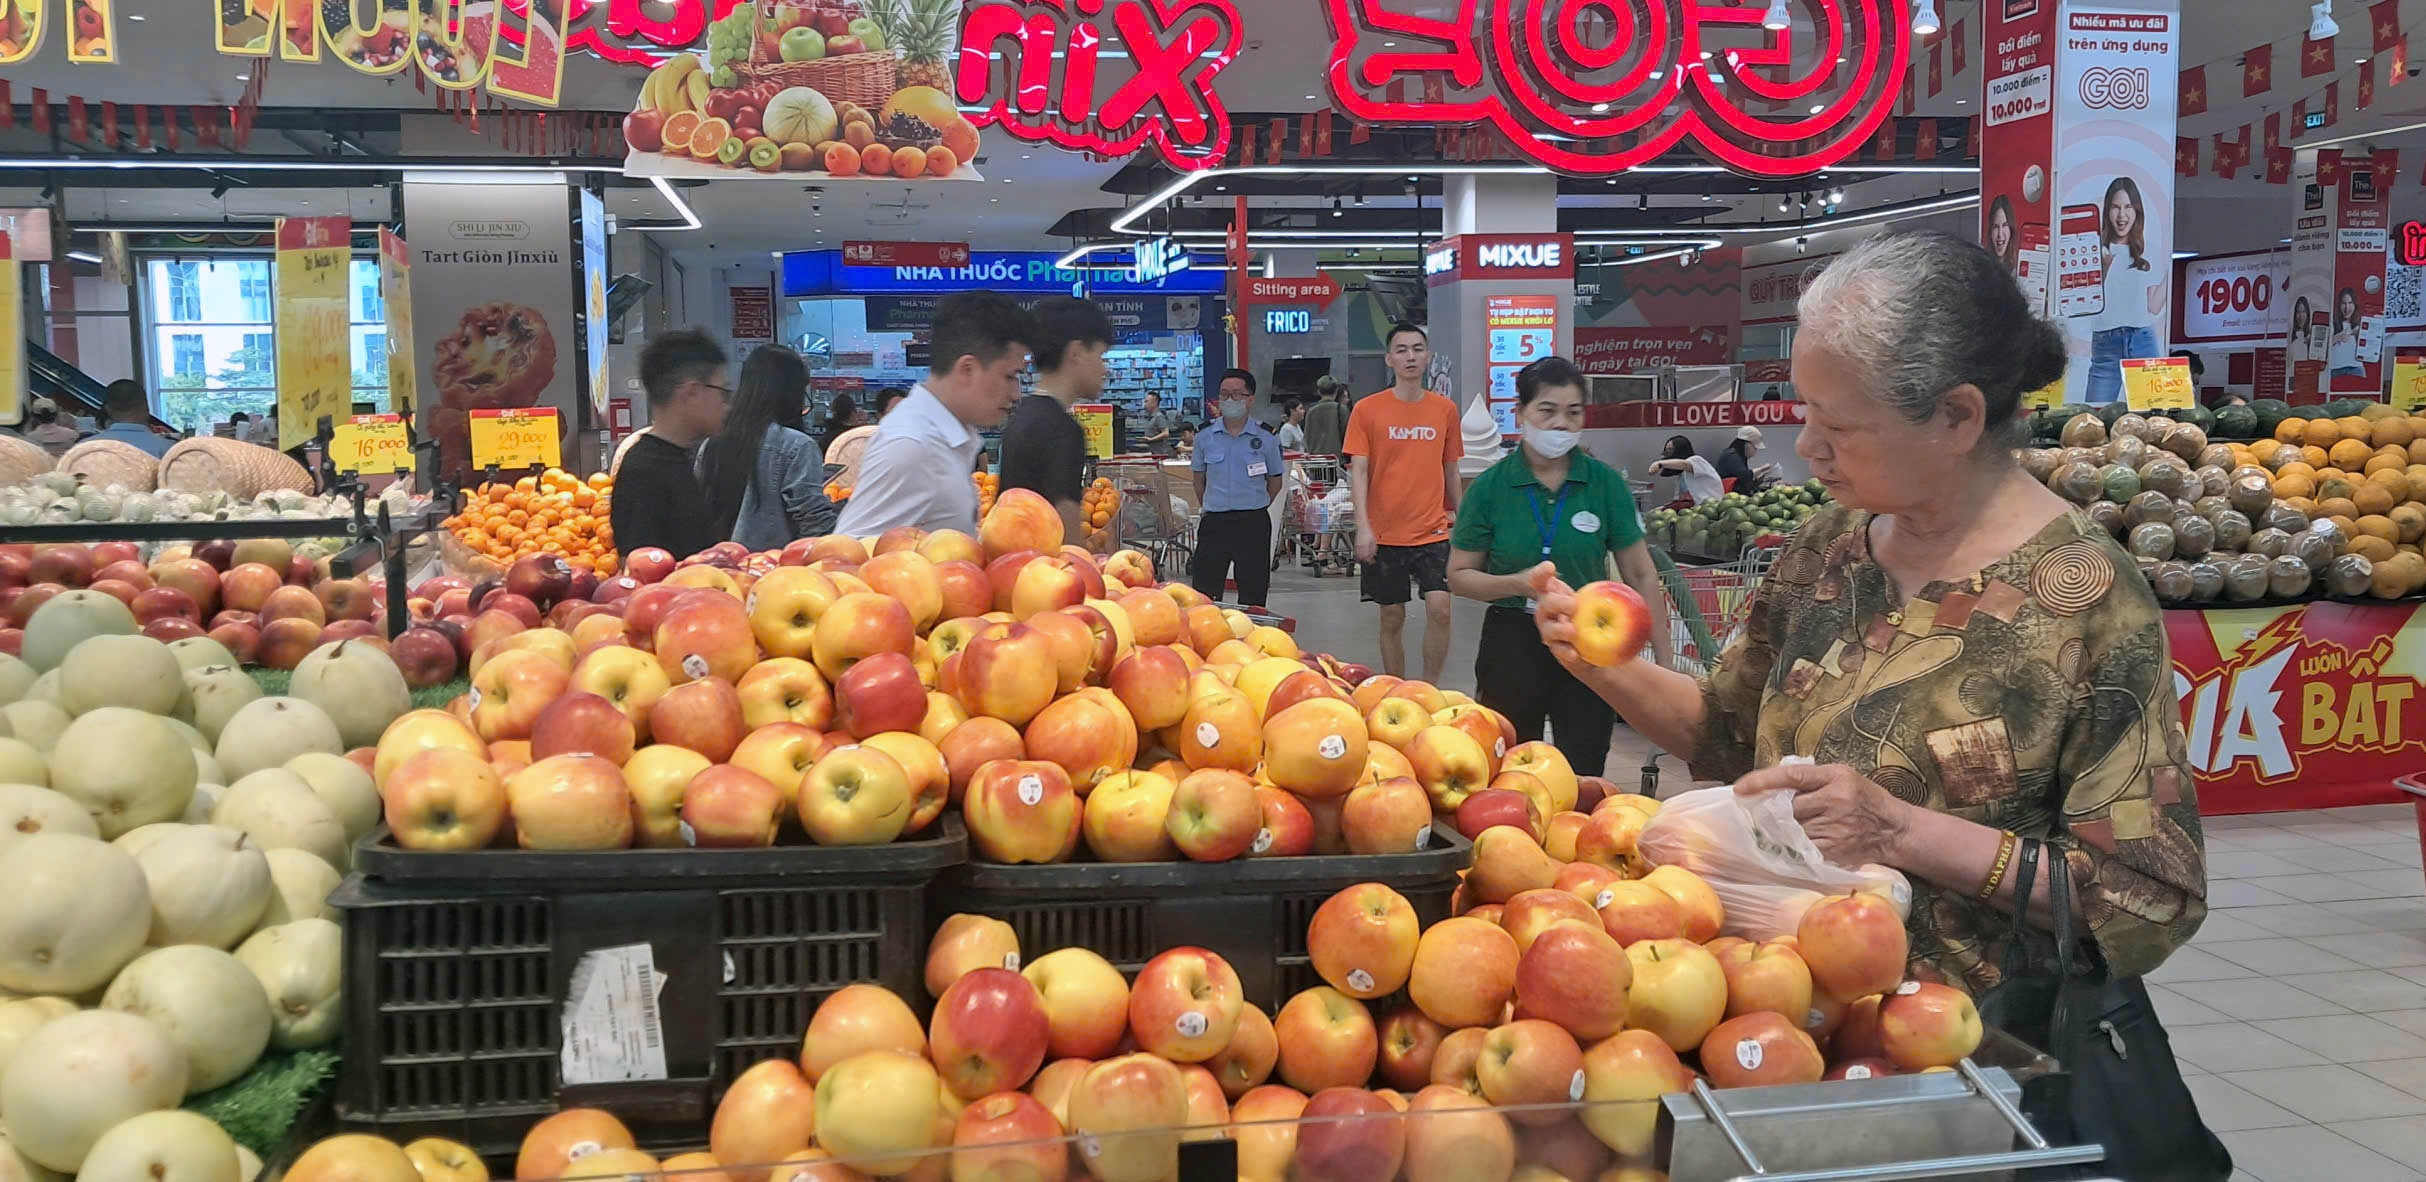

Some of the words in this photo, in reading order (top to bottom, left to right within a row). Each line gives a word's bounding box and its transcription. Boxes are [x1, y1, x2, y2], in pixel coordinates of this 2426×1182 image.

[2109, 18, 2126, 28] mã
[2129, 19, 2144, 29] ưu
[2146, 18, 2164, 29] đãi
[2069, 38, 2097, 50] trên
[2102, 38, 2128, 53] ứng
[2133, 39, 2168, 54] dụng
[1993, 80, 2019, 95] 10.000
[2079, 66, 2149, 110] GO!
[1992, 97, 2032, 121] 10.000
[2307, 113, 2325, 127] EXIT
[457, 224, 474, 232] SHI
[422, 251, 458, 263] Tart
[463, 250, 502, 263] Giòn
[1479, 244, 1560, 267] MIXUE
[1253, 282, 1297, 298] Sitting
[1300, 285, 1330, 295] area
[2197, 274, 2272, 314] 1900
[1266, 311, 1309, 333] FRICO
[1575, 340, 1629, 354] nghiệm
[1633, 339, 1662, 352] trọn
[1667, 340, 1693, 351] vẹn
[1589, 358, 1625, 371] ngày
[1657, 407, 1662, 424] I
[1673, 405, 1730, 424] LOVE
[1741, 404, 1784, 423] YOU
[1389, 426, 1436, 440] KAMITO
[2300, 648, 2342, 677] LUÔN
[2175, 642, 2302, 778] IÁ
[2301, 641, 2415, 746] BẤT
